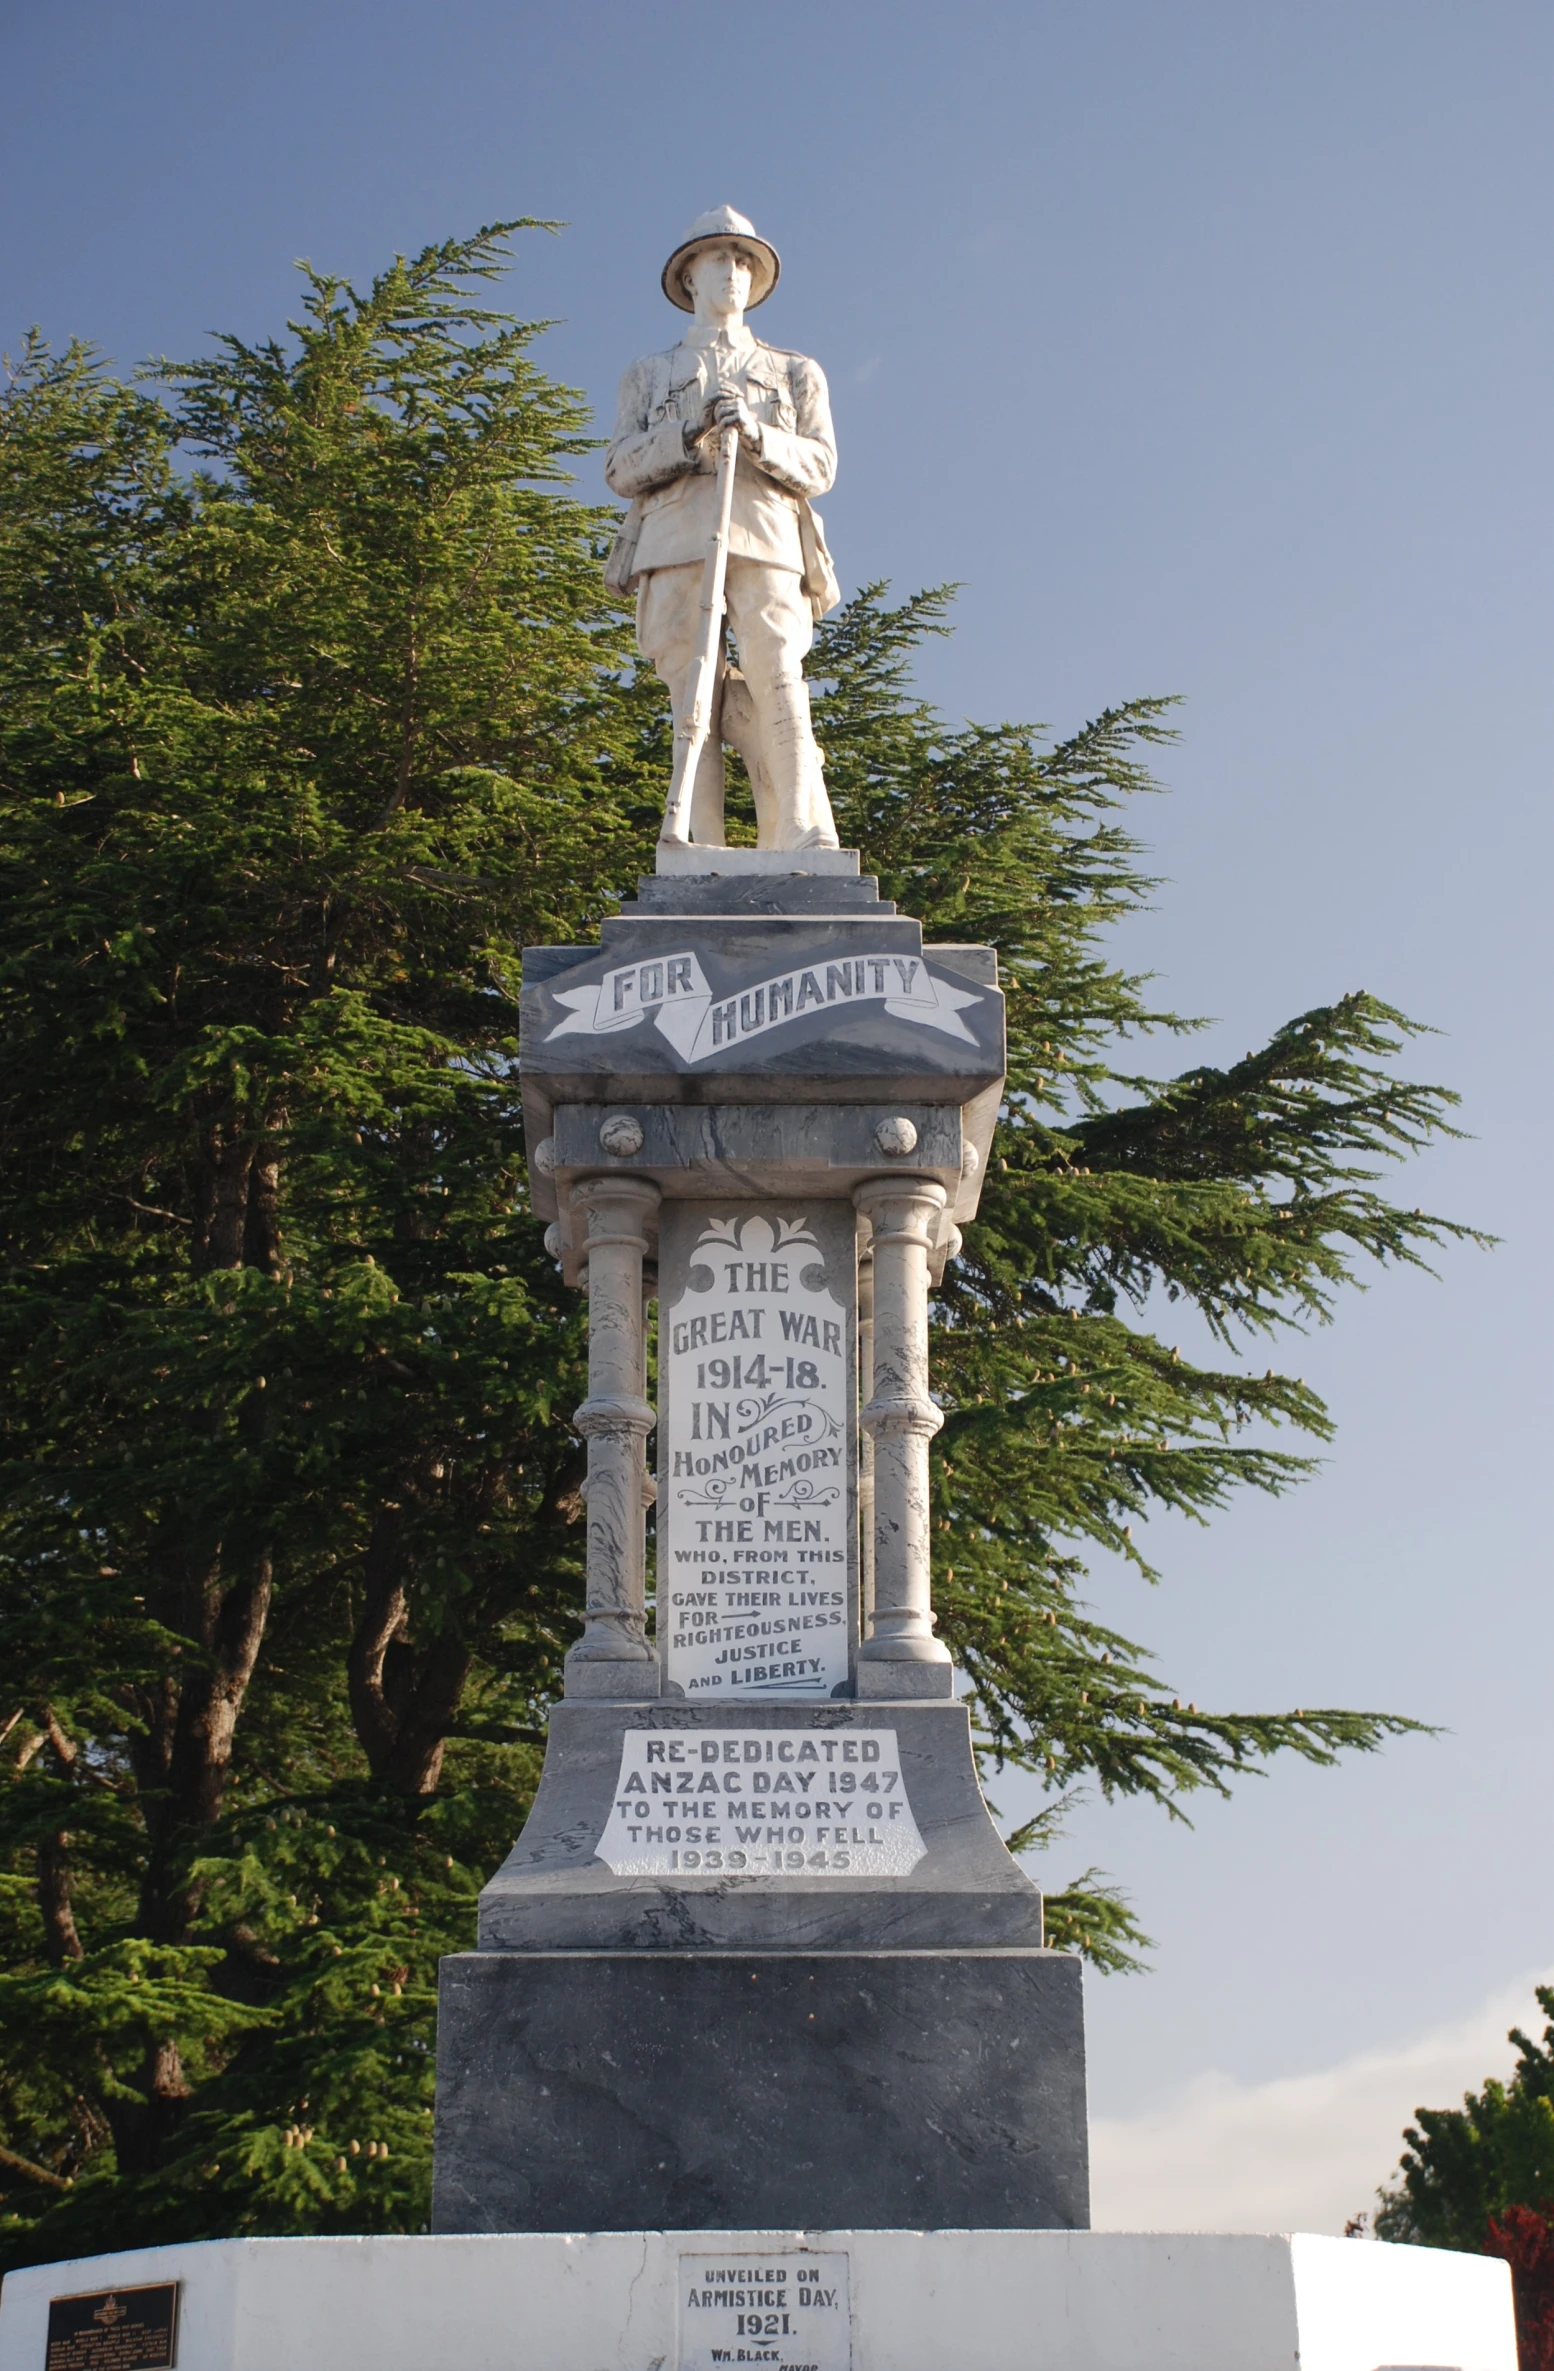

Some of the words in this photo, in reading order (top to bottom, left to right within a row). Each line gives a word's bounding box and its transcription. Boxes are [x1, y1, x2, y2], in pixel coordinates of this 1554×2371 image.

[613, 956, 694, 1011] FOR
[712, 958, 920, 1046] HUMANITY
[724, 1262, 789, 1294] THE
[673, 1309, 766, 1355] GREAT
[778, 1309, 842, 1358] WAR
[697, 1354, 827, 1389] 1914-18.
[691, 1402, 731, 1440] IN
[672, 1413, 813, 1477] HONOURED
[739, 1447, 843, 1489] MEMORY
[739, 1491, 771, 1518] OF
[695, 1520, 754, 1543] THE
[763, 1520, 830, 1543] MEN.
[674, 1550, 728, 1565] WHO,
[733, 1550, 788, 1563] FROM
[797, 1550, 845, 1563] THIS
[701, 1570, 816, 1586] DISTRICT,
[671, 1592, 718, 1606] GAVE
[725, 1592, 781, 1606] THEIR
[788, 1591, 844, 1606] LIVES
[673, 1611, 847, 1649] RIGHTEOUSNESS,
[679, 1611, 718, 1629] FOR
[714, 1639, 802, 1665] JUSTICE
[688, 1674, 723, 1689] AND
[731, 1657, 826, 1685] LIBERTY.
[646, 1740, 880, 1763] RE-DEDICATED
[623, 1771, 742, 1794] ANZAC
[752, 1771, 816, 1794] DAY
[829, 1771, 899, 1794] 1947
[617, 1801, 650, 1819] TO
[663, 1801, 717, 1819] THE
[728, 1801, 854, 1819] MEMORY
[866, 1801, 904, 1820] OF
[627, 1826, 721, 1844] THOSE
[735, 1826, 805, 1844] WHO
[817, 1827, 884, 1845] FELL
[705, 2269, 787, 2283] UNVEILED
[797, 2269, 820, 2283] ON
[687, 2288, 788, 2308] ARMISTICE
[736, 2313, 797, 2335] 1921.
